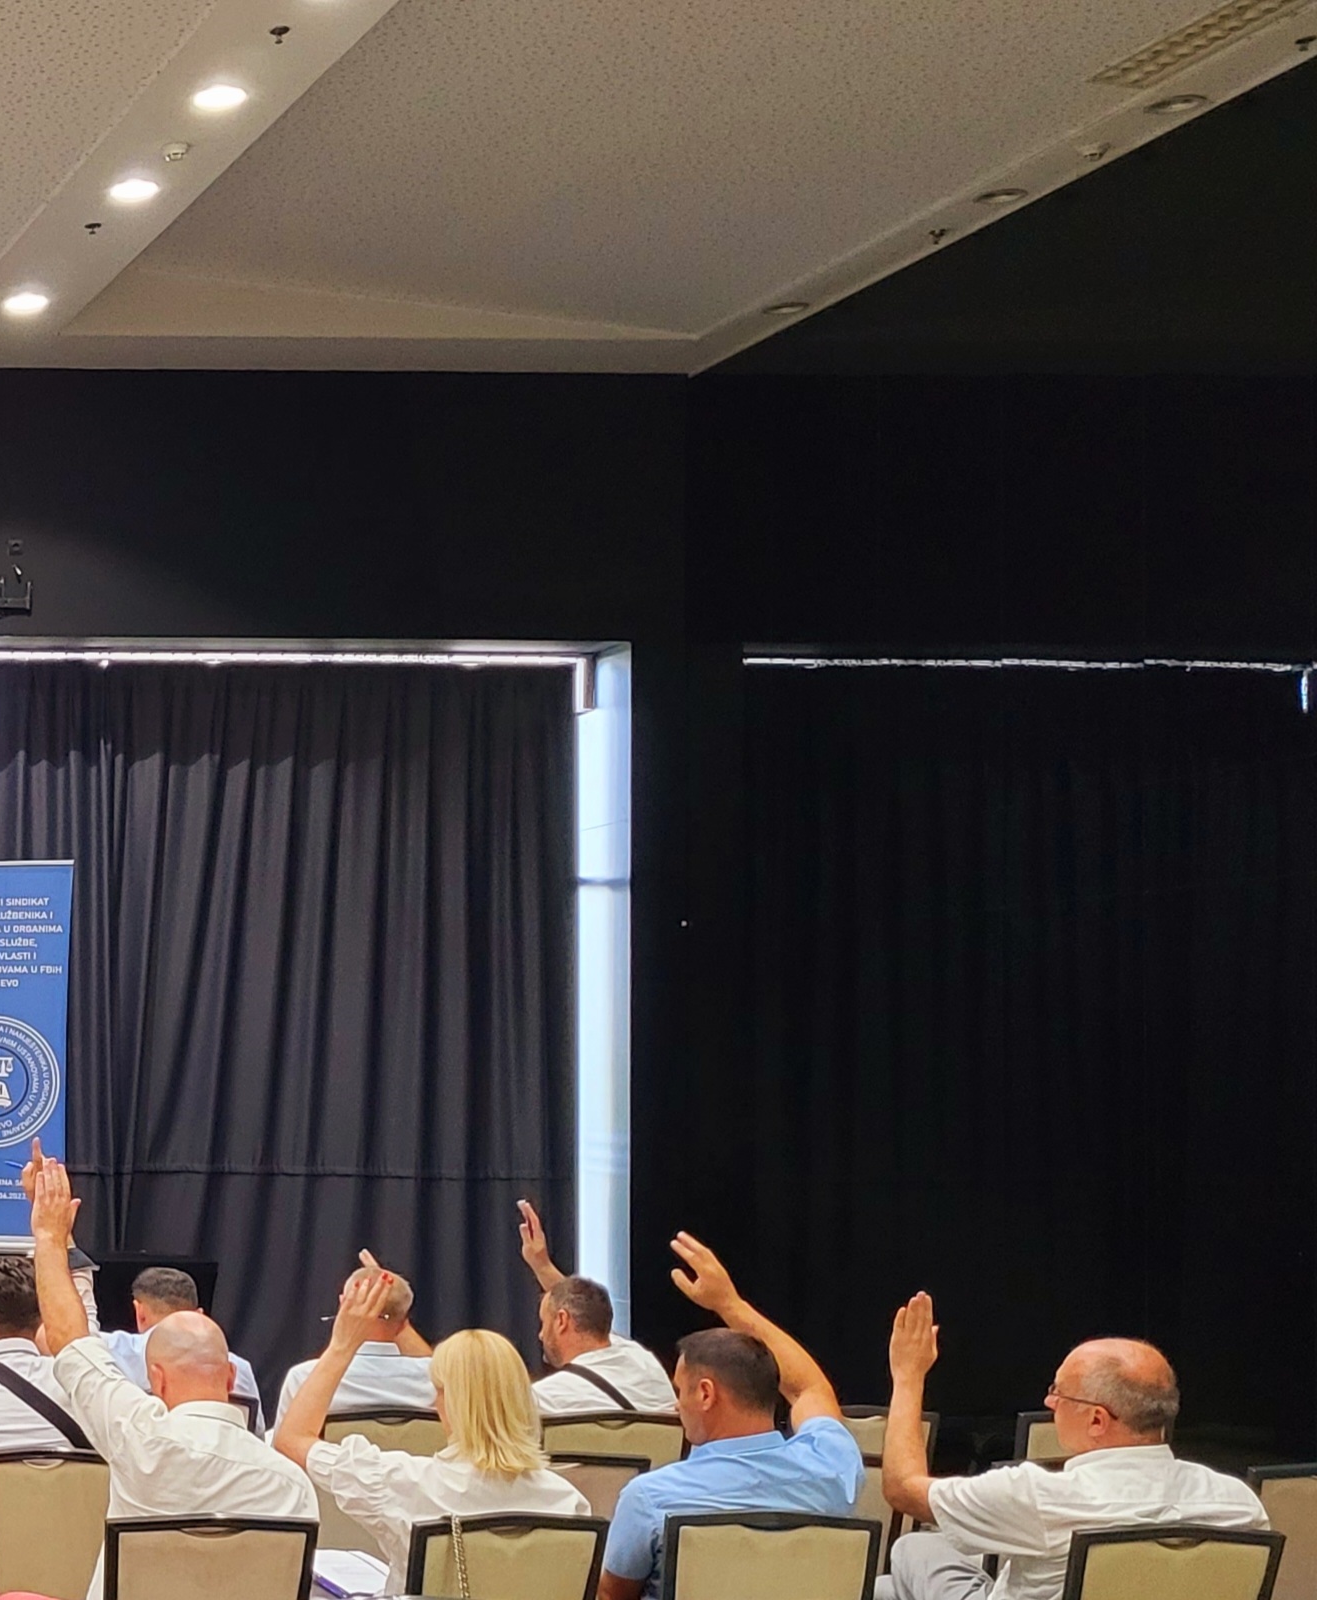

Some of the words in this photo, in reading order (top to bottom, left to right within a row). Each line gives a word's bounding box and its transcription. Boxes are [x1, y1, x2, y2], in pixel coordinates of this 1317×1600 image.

[6, 897, 50, 906] SINDIKAT
[3, 925, 11, 933] U
[12, 924, 63, 933] ORGANIMA
[0, 936, 38, 948] SLUŽBE,
[30, 965, 38, 974] U
